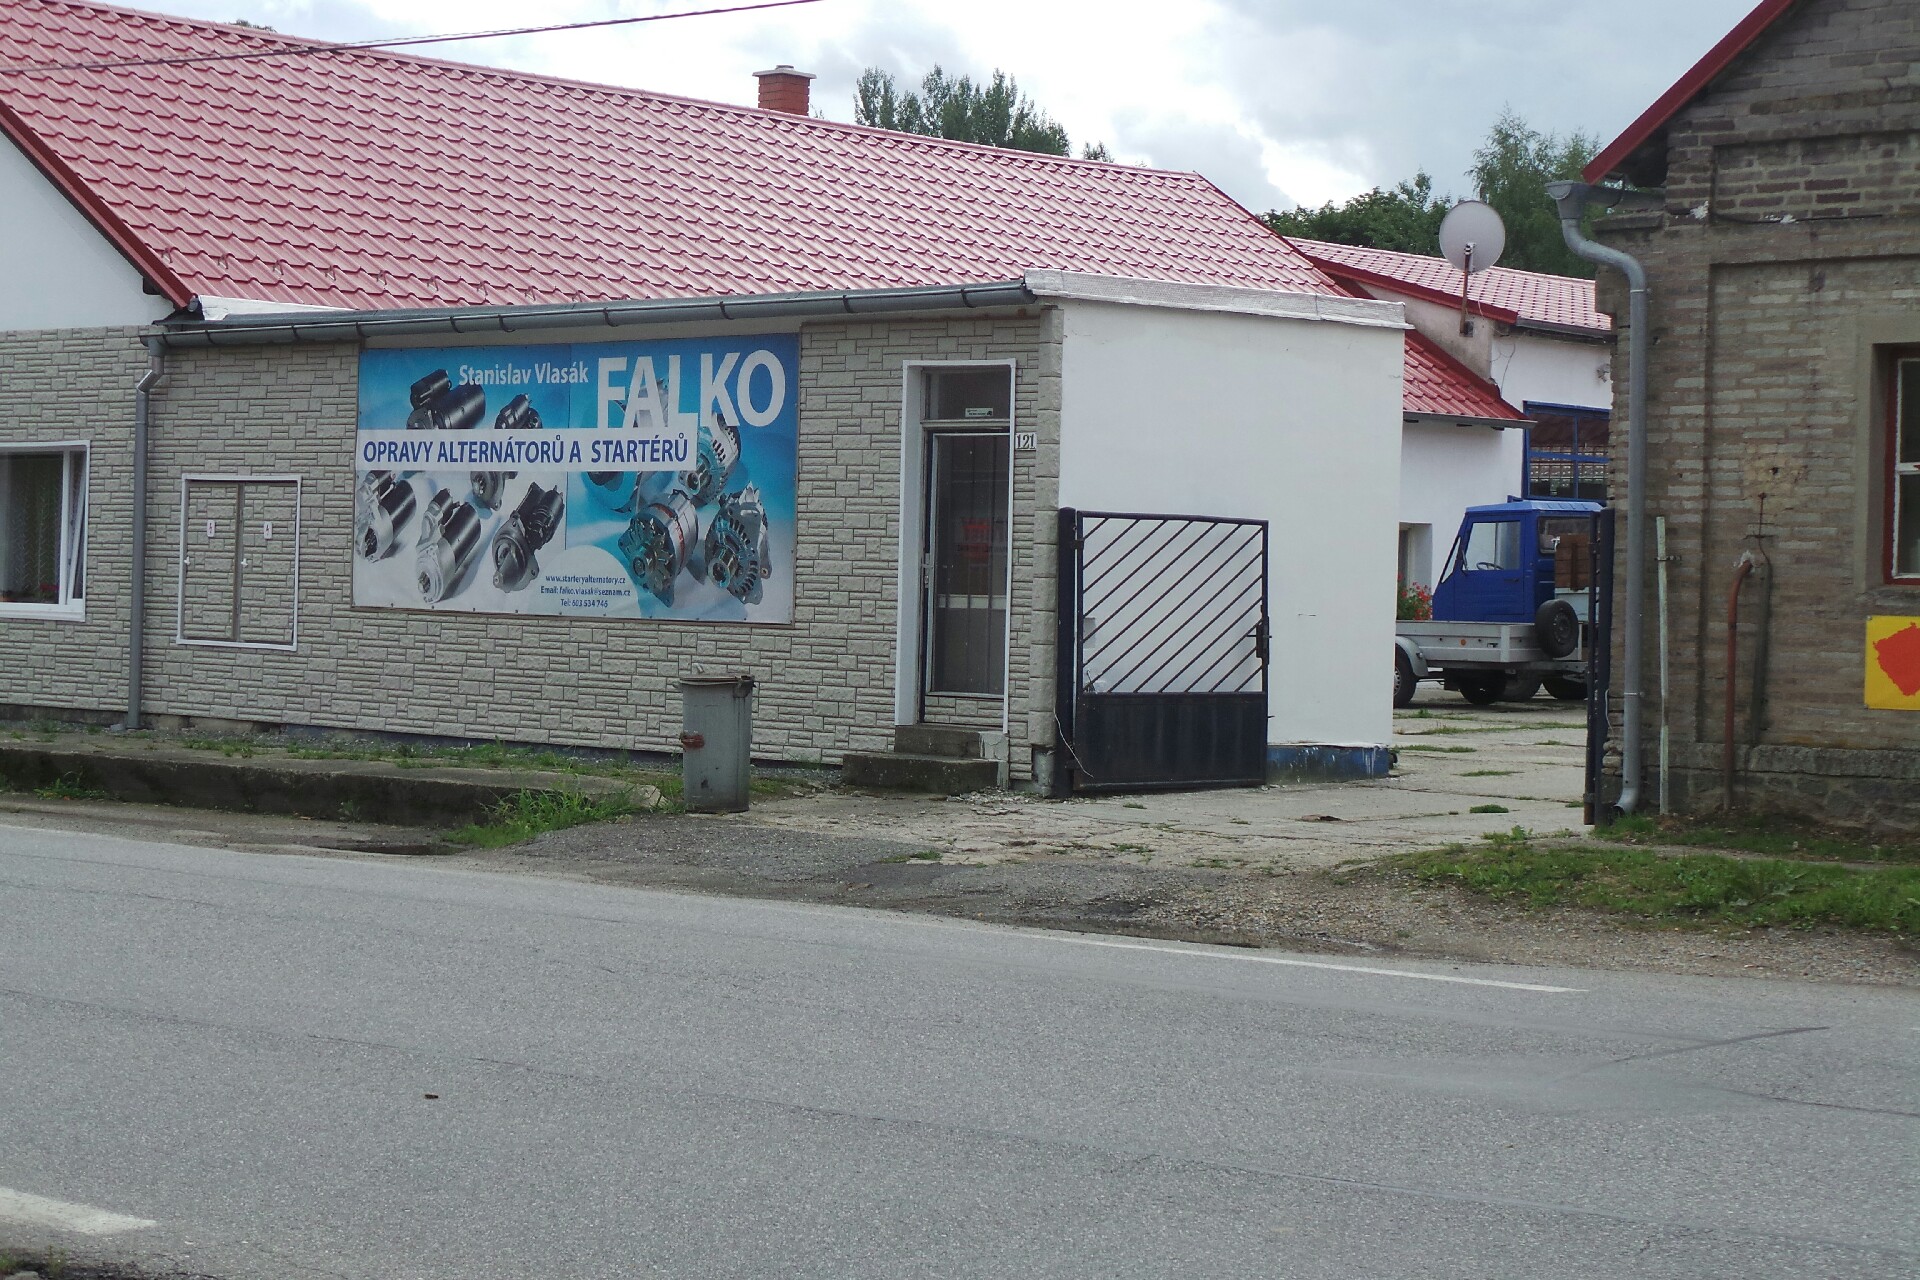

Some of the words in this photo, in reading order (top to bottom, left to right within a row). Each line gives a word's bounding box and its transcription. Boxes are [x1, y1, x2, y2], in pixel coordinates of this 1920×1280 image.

[459, 363, 531, 386] Stanislav
[535, 360, 588, 383] Vlasák
[598, 350, 786, 429] FALKO
[364, 440, 433, 464] OPRAVY
[437, 434, 563, 464] ALTERNÁTORŮ
[569, 444, 581, 463] A
[591, 432, 688, 464] STARTÉRŮ
[1017, 434, 1035, 449] 121
